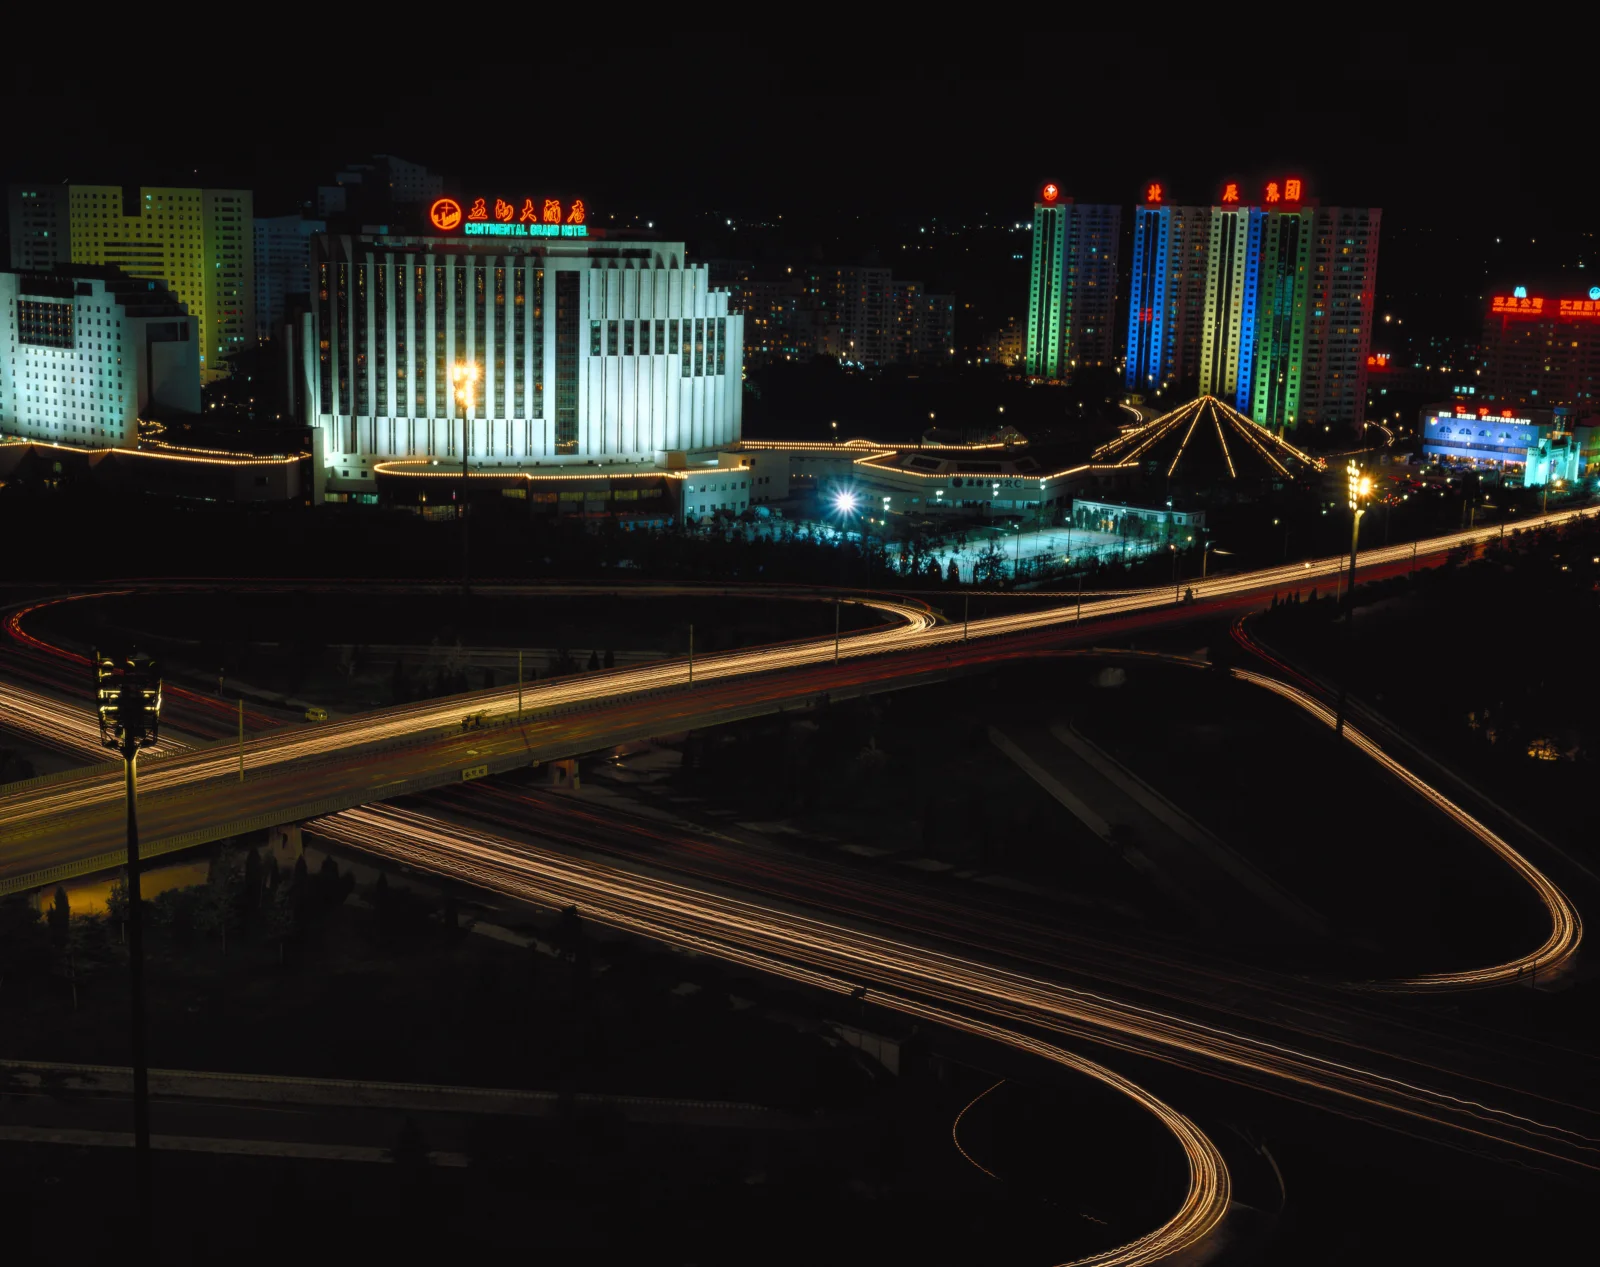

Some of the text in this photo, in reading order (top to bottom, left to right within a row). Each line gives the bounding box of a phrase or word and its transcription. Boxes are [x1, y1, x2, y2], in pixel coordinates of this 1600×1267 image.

[468, 199, 585, 224] 五洲大酒店
[465, 223, 589, 237] CONTINENTAL GRAND HOTEL
[1481, 415, 1531, 425] RESTAURANT
